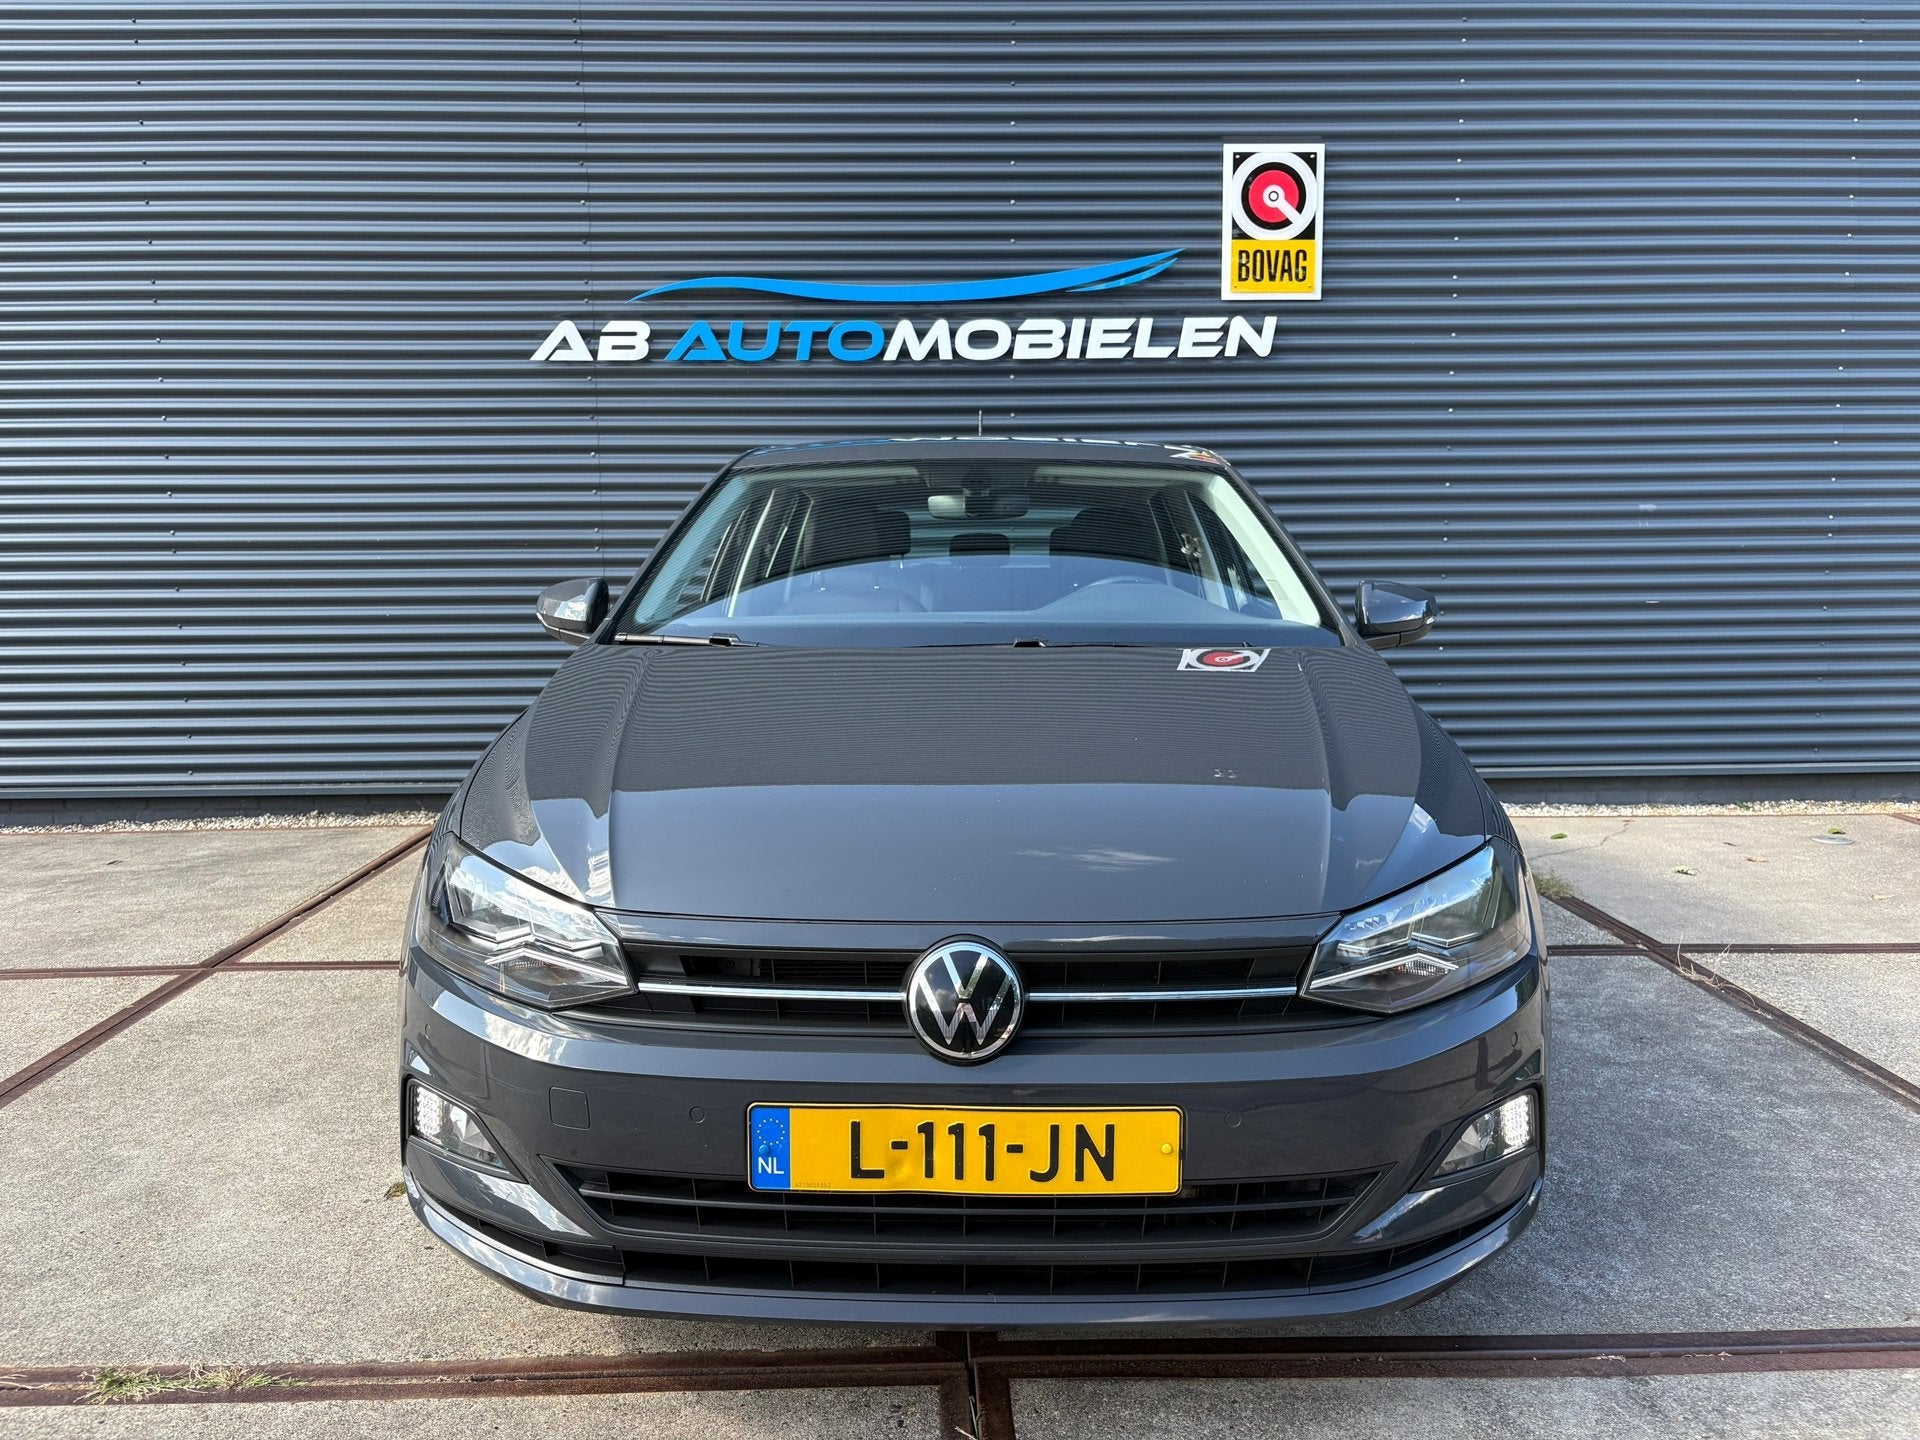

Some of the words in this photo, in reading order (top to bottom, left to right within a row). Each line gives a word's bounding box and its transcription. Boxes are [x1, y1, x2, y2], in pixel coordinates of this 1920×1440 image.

[1237, 248, 1307, 283] BOVAG
[529, 319, 651, 362] AB
[663, 315, 1278, 362] AUTOMOBIELEN
[757, 1155, 785, 1175] NL
[849, 1119, 1116, 1183] L-111-JN
